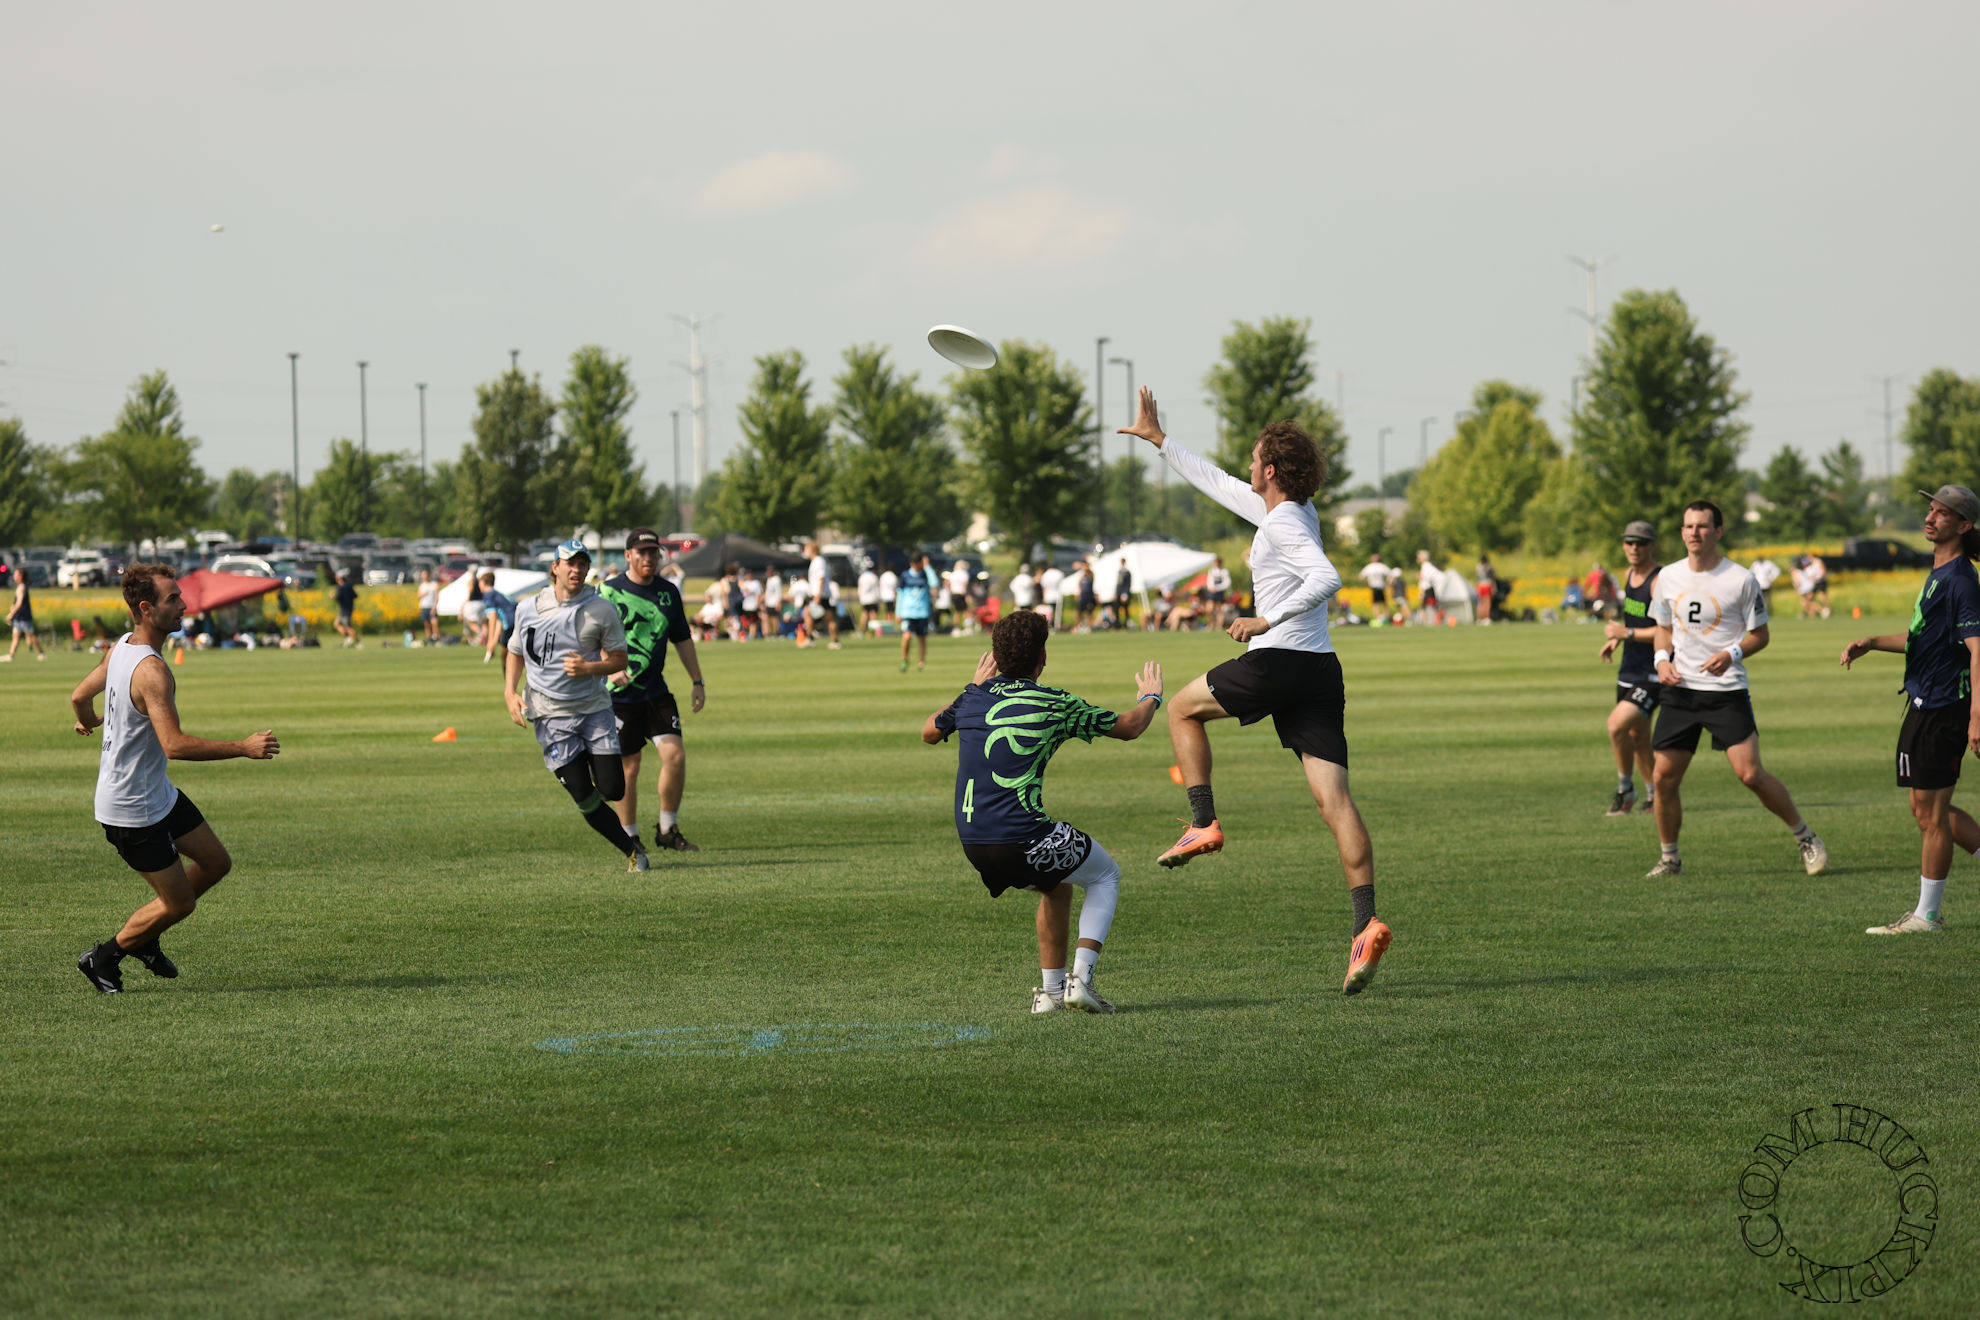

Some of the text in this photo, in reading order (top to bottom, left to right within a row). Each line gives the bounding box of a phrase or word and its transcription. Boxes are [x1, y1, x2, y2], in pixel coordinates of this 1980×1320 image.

[657, 591, 672, 606] 23
[1688, 601, 1701, 623] 2
[962, 778, 975, 823] 4
